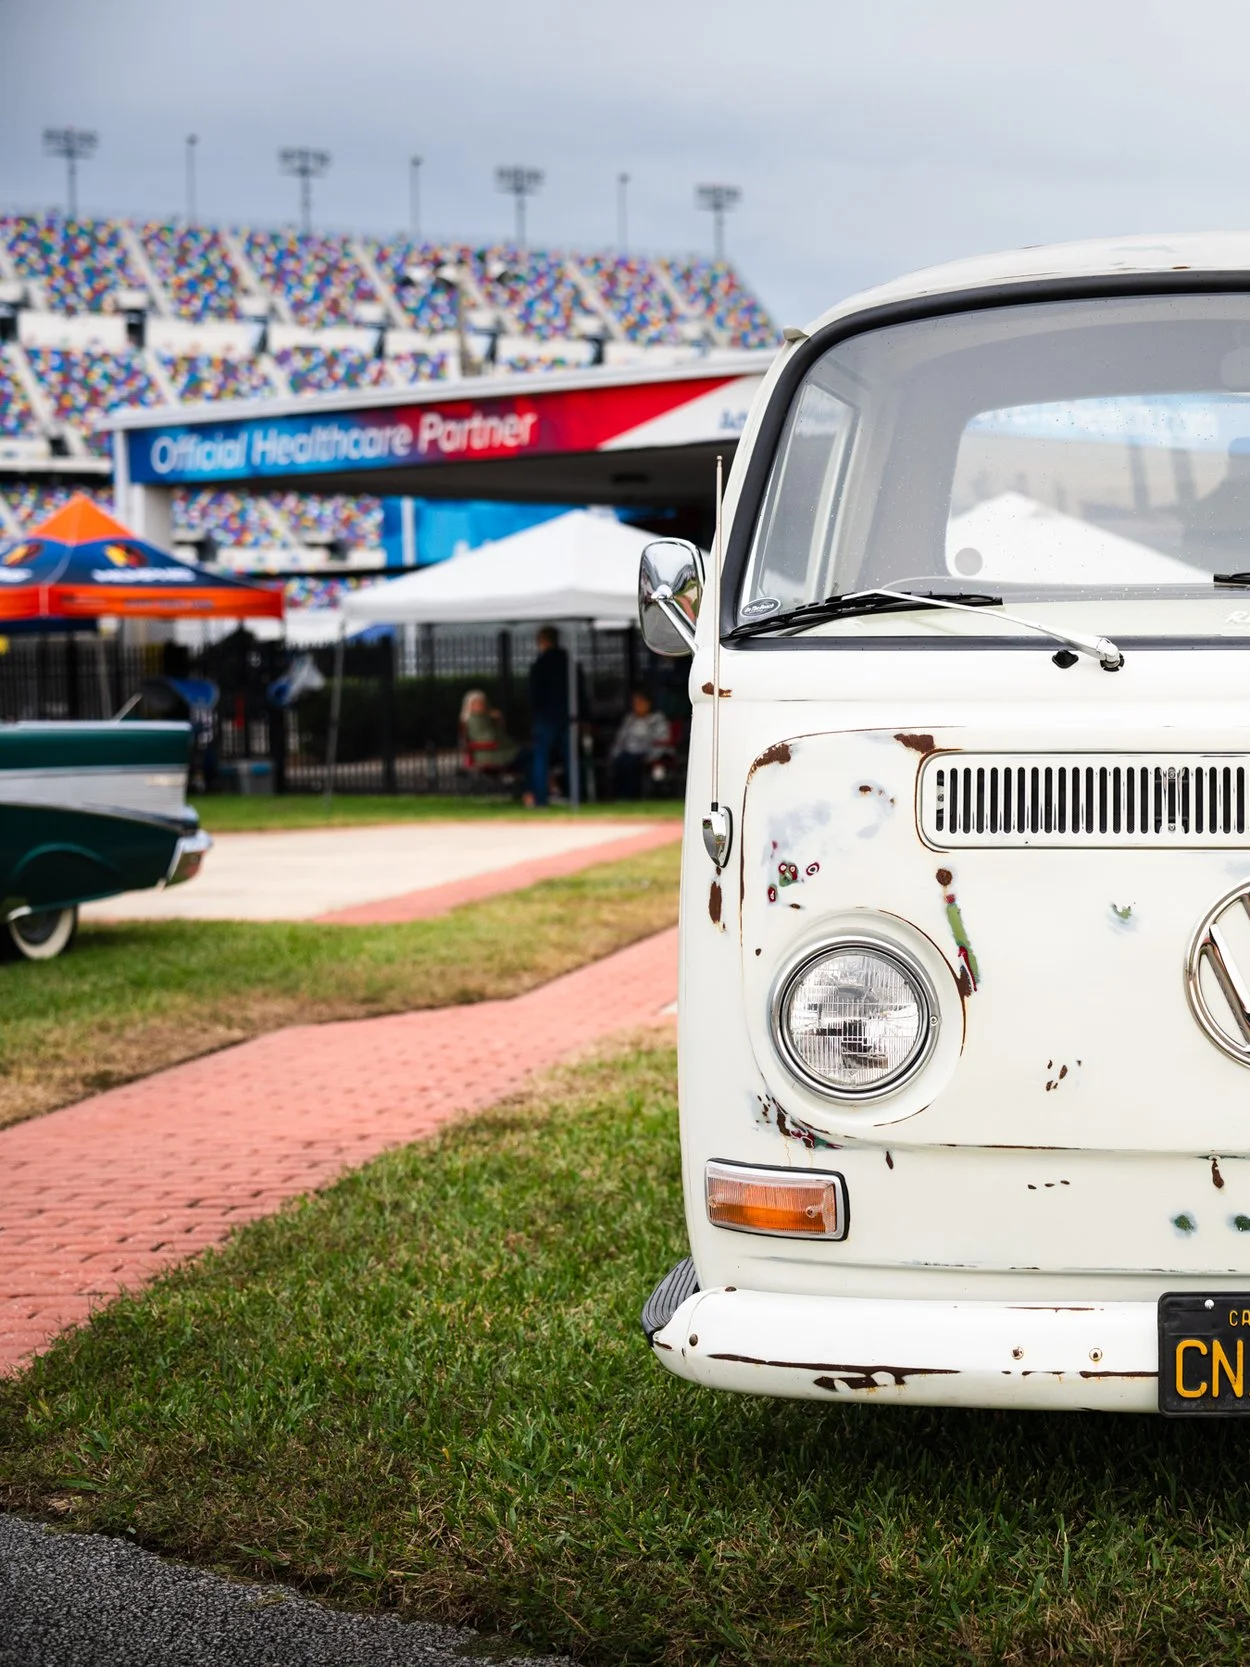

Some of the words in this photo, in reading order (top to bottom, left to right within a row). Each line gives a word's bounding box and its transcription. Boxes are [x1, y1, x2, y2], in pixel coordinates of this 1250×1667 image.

[151, 431, 248, 474] Official
[252, 423, 413, 466] Healthcare
[418, 412, 537, 454] Partner
